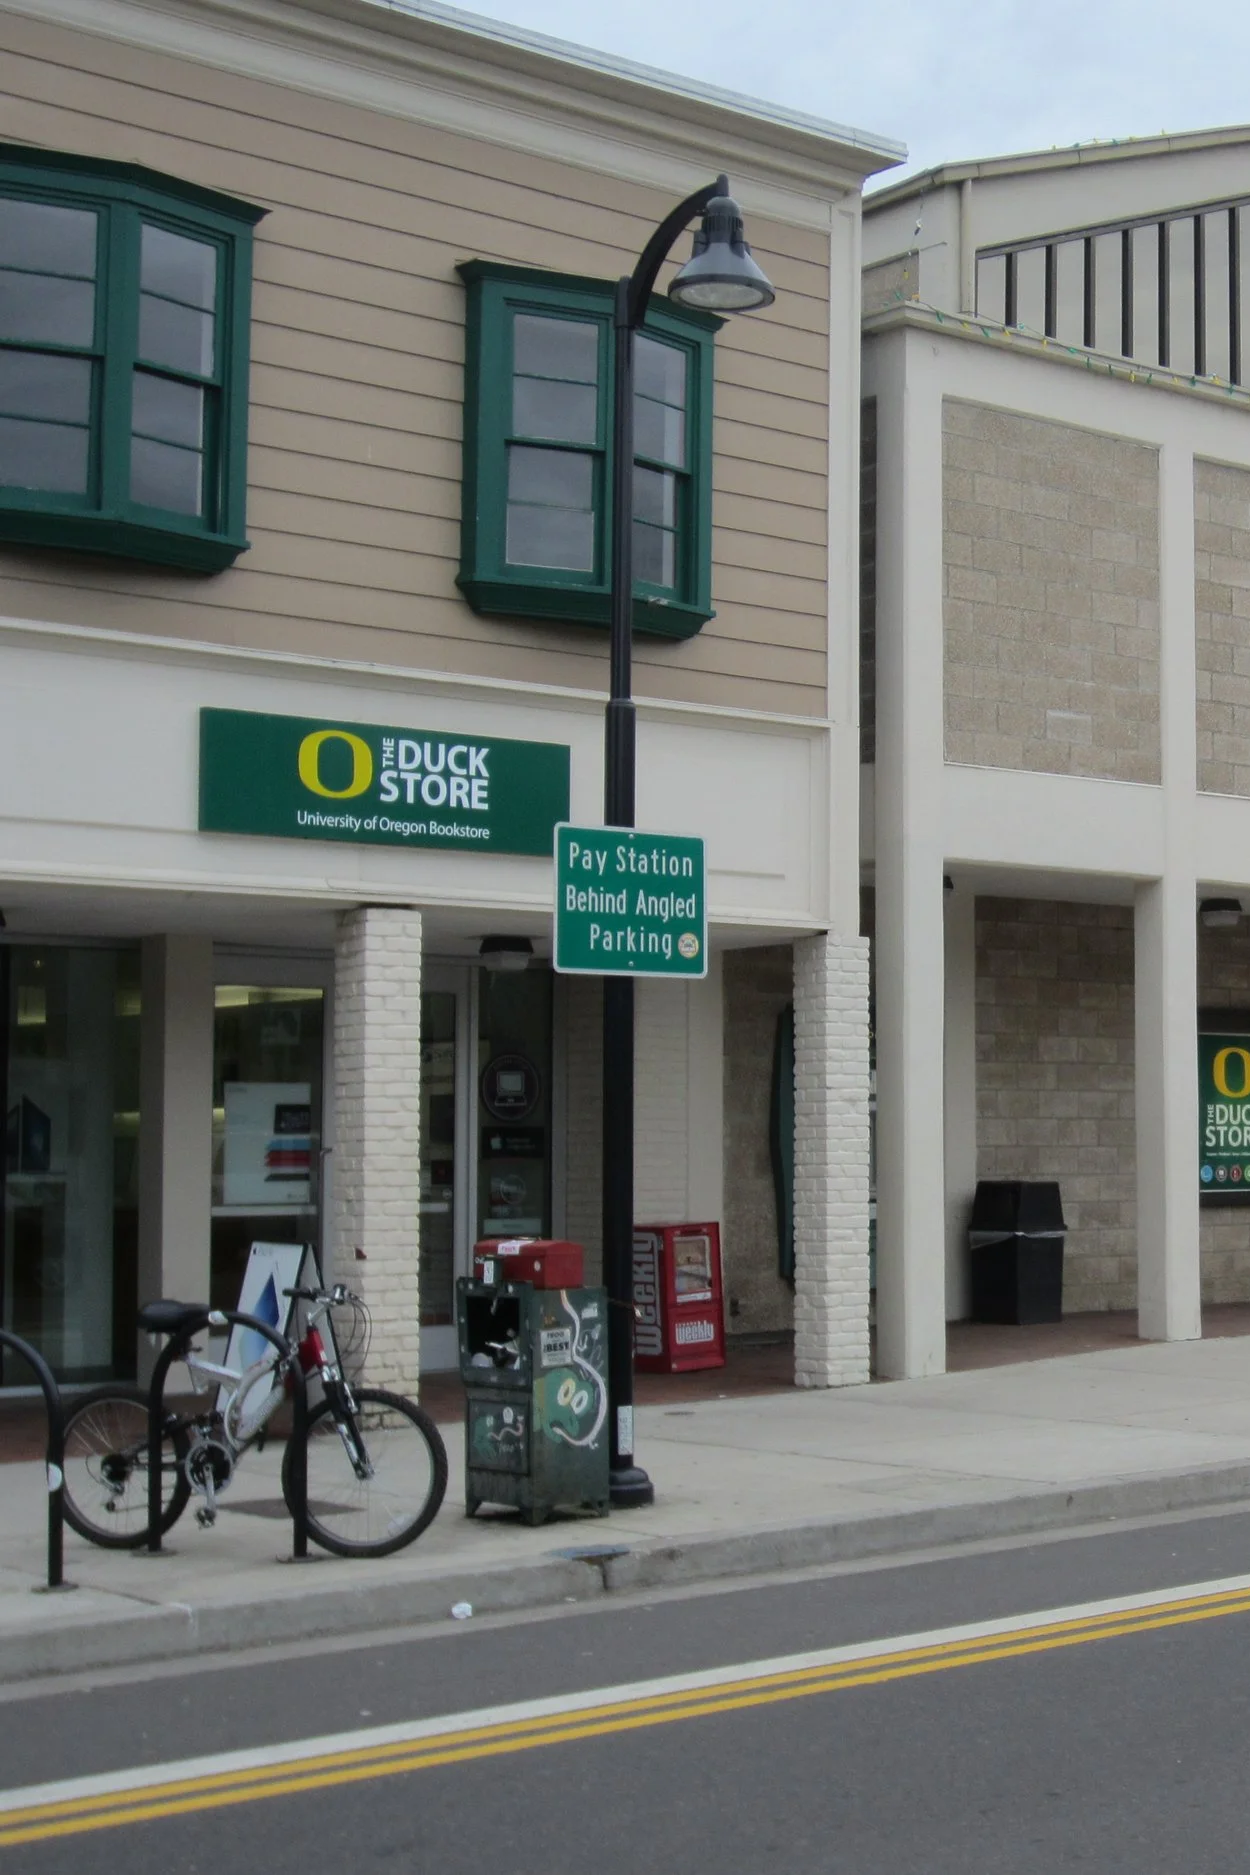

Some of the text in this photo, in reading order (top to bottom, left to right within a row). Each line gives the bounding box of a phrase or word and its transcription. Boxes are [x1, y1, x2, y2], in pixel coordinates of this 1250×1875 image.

[298, 729, 373, 799] O
[382, 737, 489, 778] THE DUCK
[379, 770, 489, 810] STORE
[297, 810, 490, 839] University of Oregon Bookstore
[569, 841, 693, 877] Pay Station
[566, 884, 696, 923] Behind Angled
[590, 923, 672, 960] Parking
